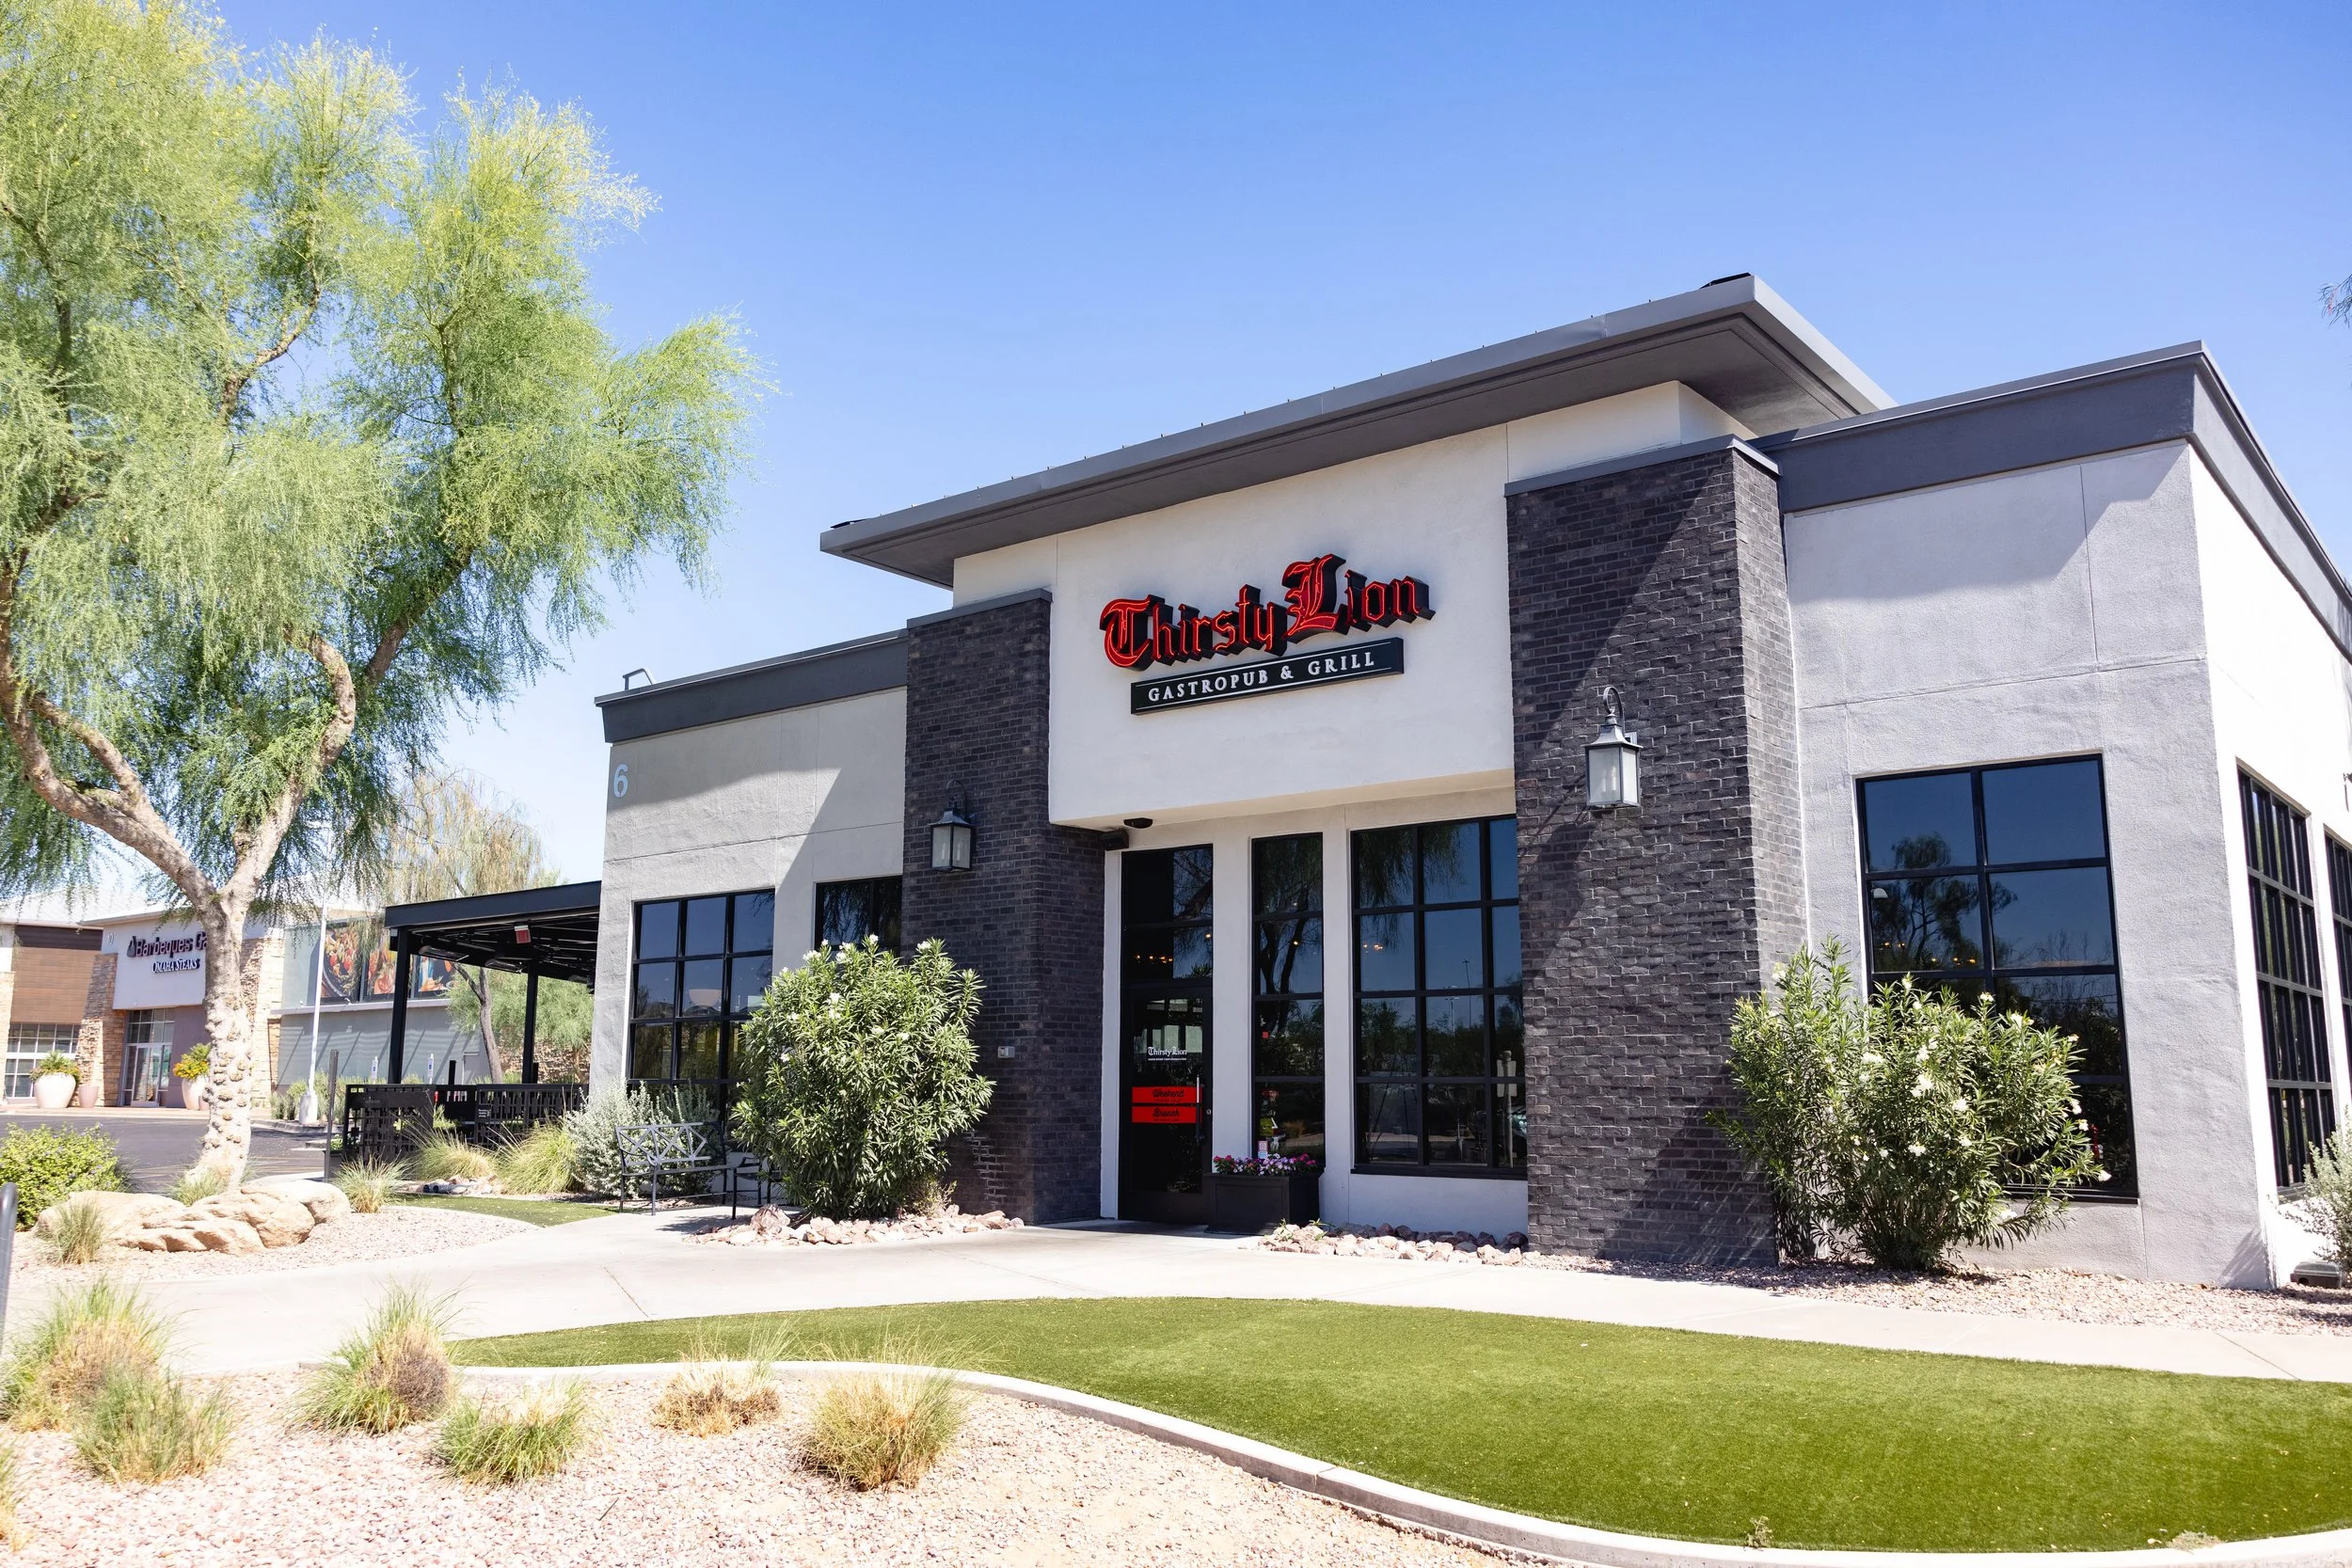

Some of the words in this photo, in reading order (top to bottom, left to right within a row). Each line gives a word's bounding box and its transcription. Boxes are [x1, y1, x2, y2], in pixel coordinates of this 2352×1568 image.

[1100, 584, 1287, 671] Thirsty
[1281, 553, 1436, 643] Lion
[1148, 671, 1269, 703] GASTROPUB
[1279, 666, 1295, 680] &
[1308, 652, 1375, 675] GRILL
[613, 763, 628, 799] 6
[135, 937, 193, 958] Barbeques
[152, 962, 175, 974] OMAHA
[175, 958, 200, 972] STEAKS
[1148, 1046, 1170, 1057] Thirsty
[1171, 1046, 1187, 1055] Lion
[1152, 1088, 1184, 1098] Weekend
[1152, 1108, 1180, 1117] Brunch
